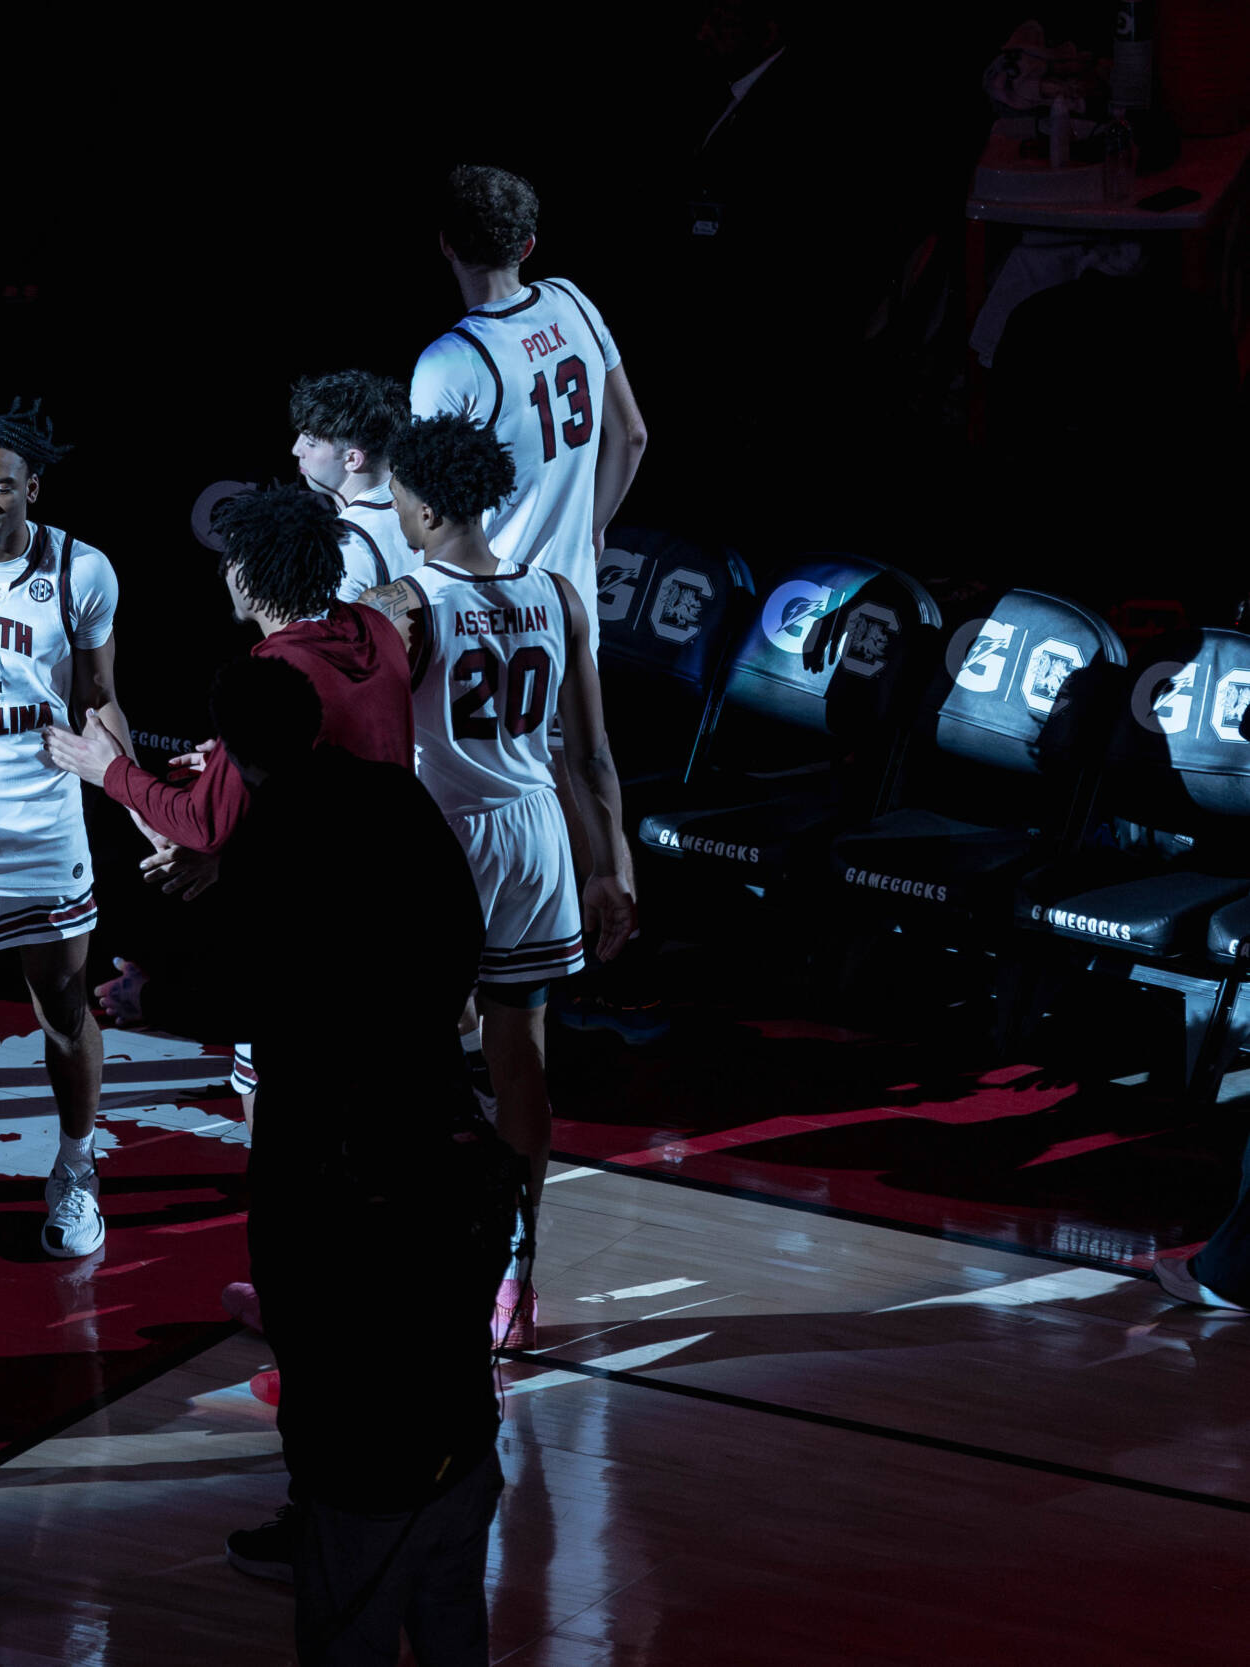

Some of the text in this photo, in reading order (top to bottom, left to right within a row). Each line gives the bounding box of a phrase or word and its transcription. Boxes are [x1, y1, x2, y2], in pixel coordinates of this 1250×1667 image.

[521, 323, 567, 362] POLK
[530, 354, 593, 463] 13
[454, 605, 548, 637] ASSEMIAN
[452, 646, 551, 741] 20
[130, 729, 192, 753] ECOCKS
[659, 829, 760, 863] GAMECOCKS
[845, 867, 948, 901] GAMECOCKS
[1031, 904, 1132, 941] GAMECOCKS
